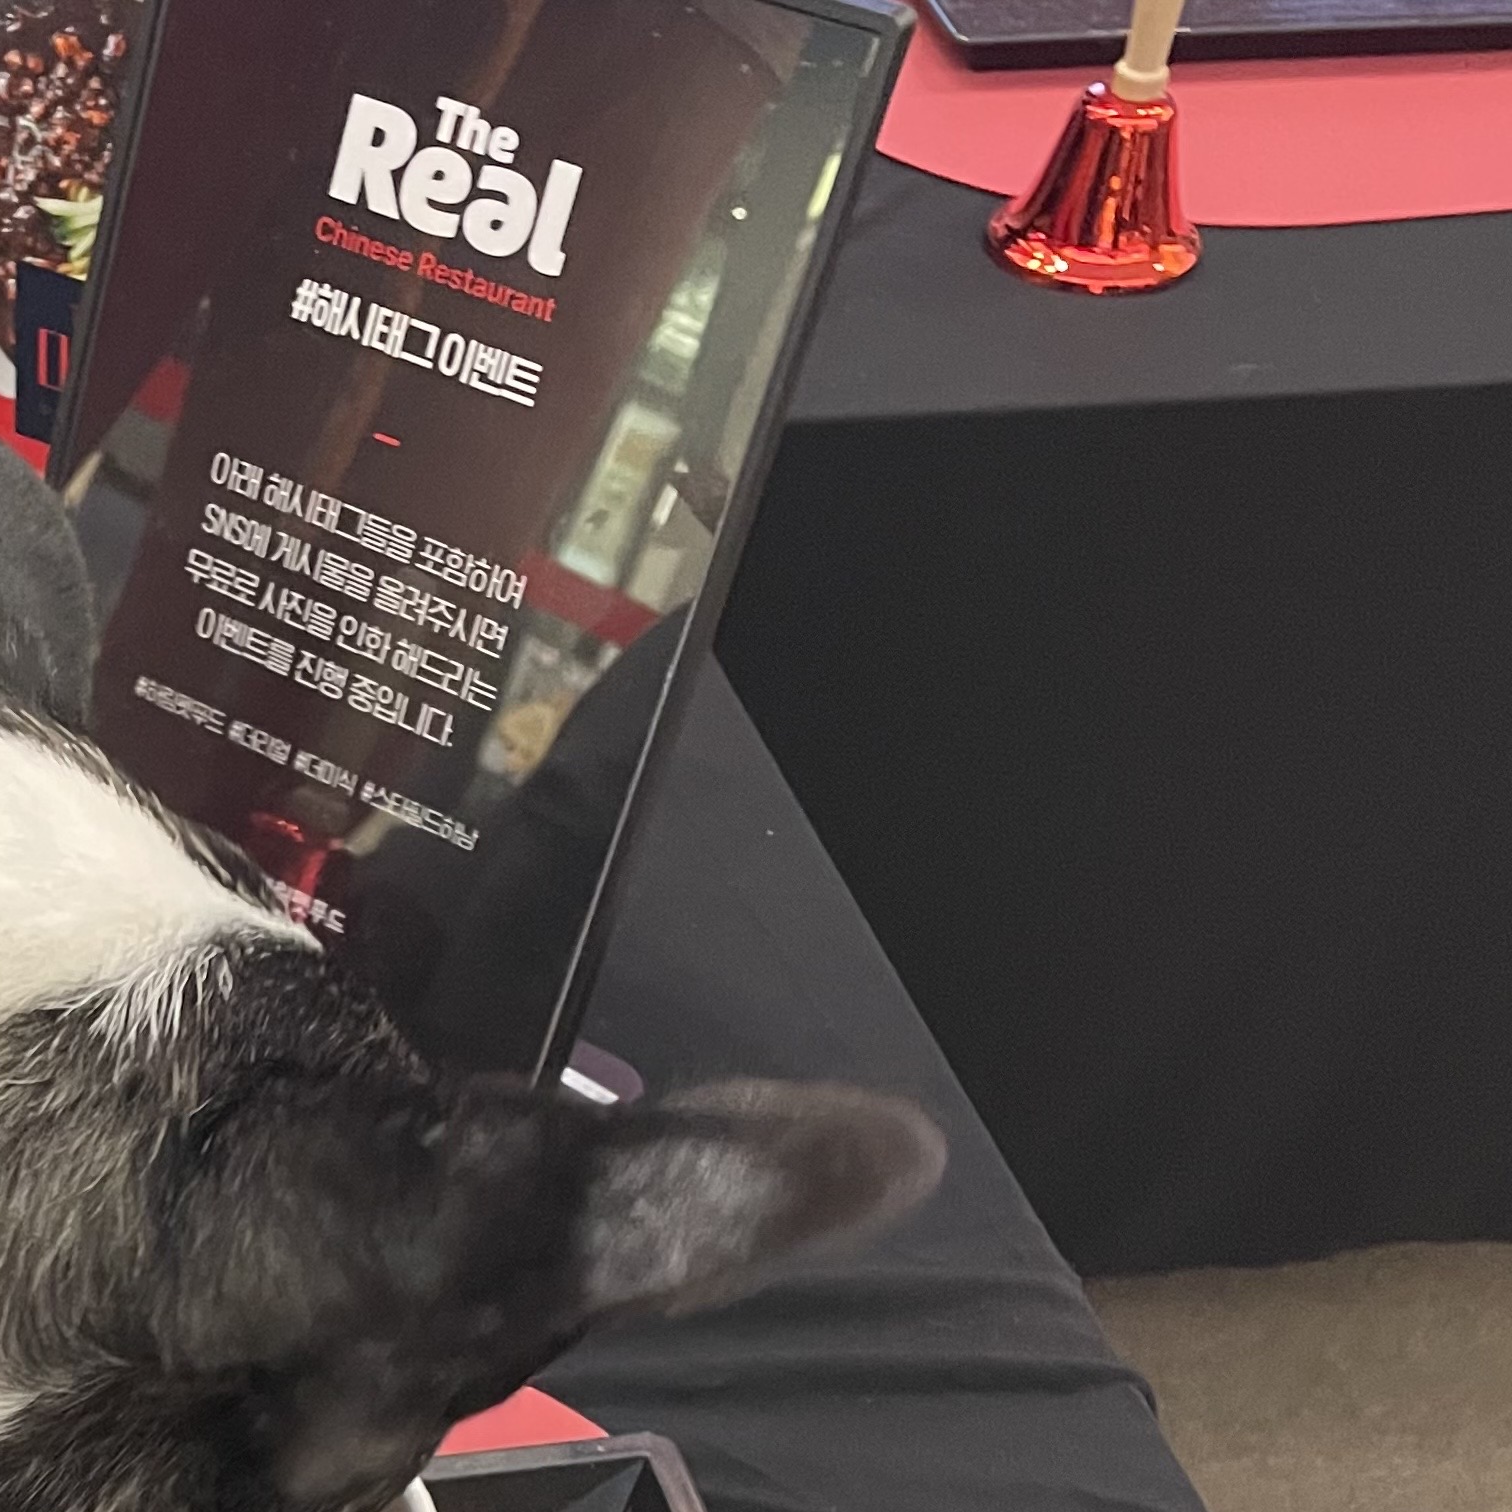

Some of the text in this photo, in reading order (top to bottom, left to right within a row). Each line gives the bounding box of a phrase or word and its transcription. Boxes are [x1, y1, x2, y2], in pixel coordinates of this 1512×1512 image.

[328, 93, 583, 277] Real
[436, 96, 519, 163] The
[314, 215, 557, 322] Chinese Restaurant
[290, 278, 543, 407] #해시태그 이벤트
[201, 503, 509, 659] SNS에 게시물을 올려주시면
[210, 452, 528, 610] 아래 해시태그들을 포함하여
[184, 548, 498, 711] 무료로 사진을 인화 해드리는
[195, 607, 296, 677] 이벤트를
[294, 650, 349, 700] 진행
